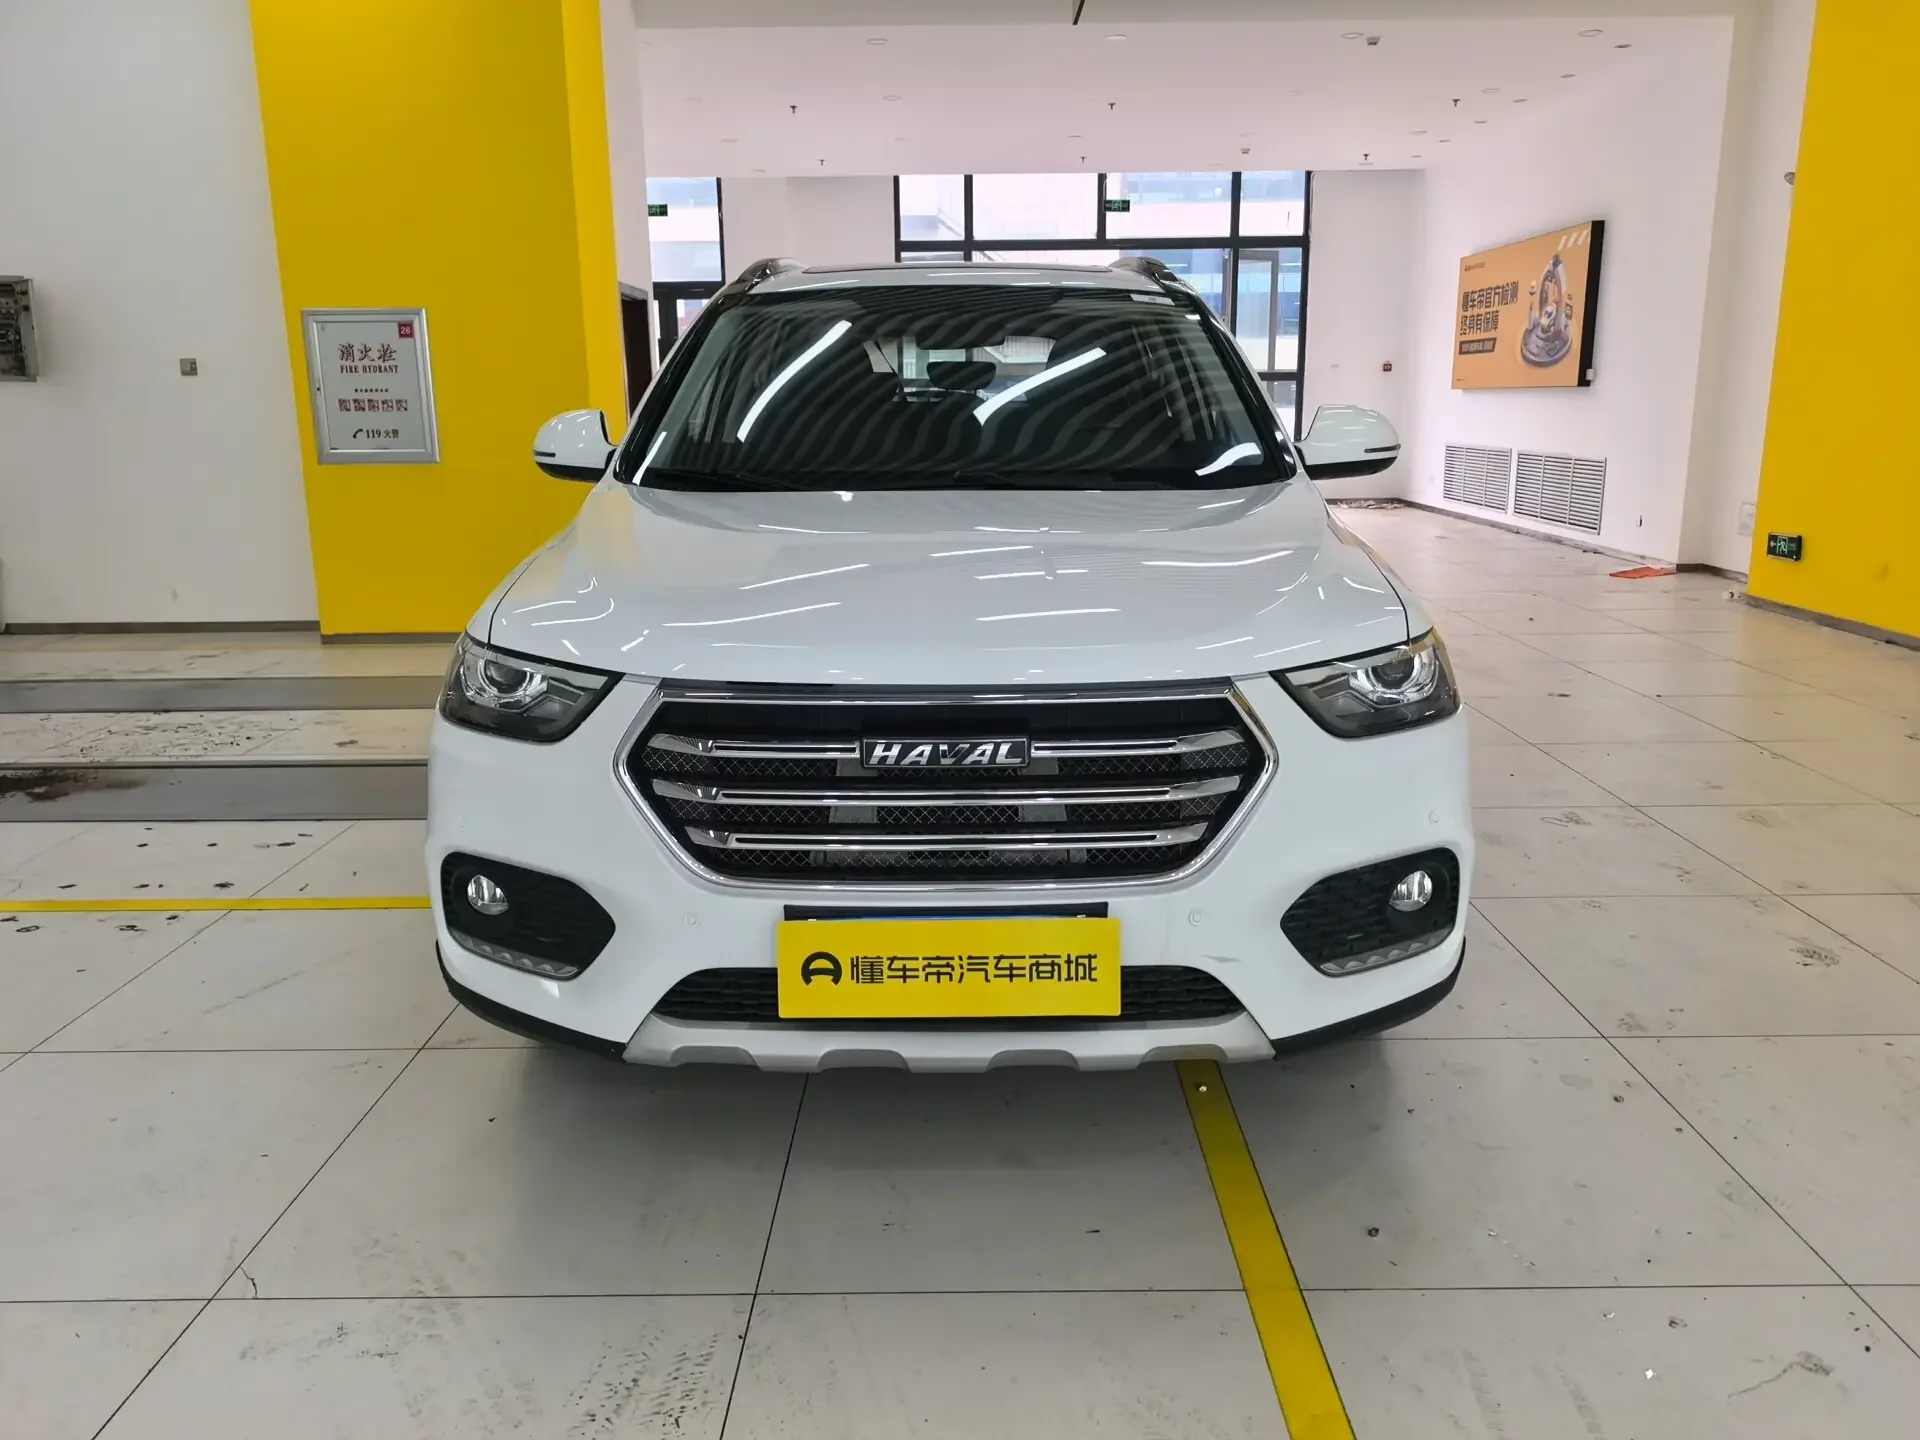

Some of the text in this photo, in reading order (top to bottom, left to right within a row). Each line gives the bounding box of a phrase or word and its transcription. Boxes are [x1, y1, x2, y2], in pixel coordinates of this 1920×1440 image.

[339, 343, 397, 362] 消火栓
[340, 365, 398, 373] FIRE HYDRANT
[366, 429, 399, 439] 119 火警
[869, 743, 1022, 765] HAVAL
[850, 953, 1097, 984] 懂车帝汽车商城
